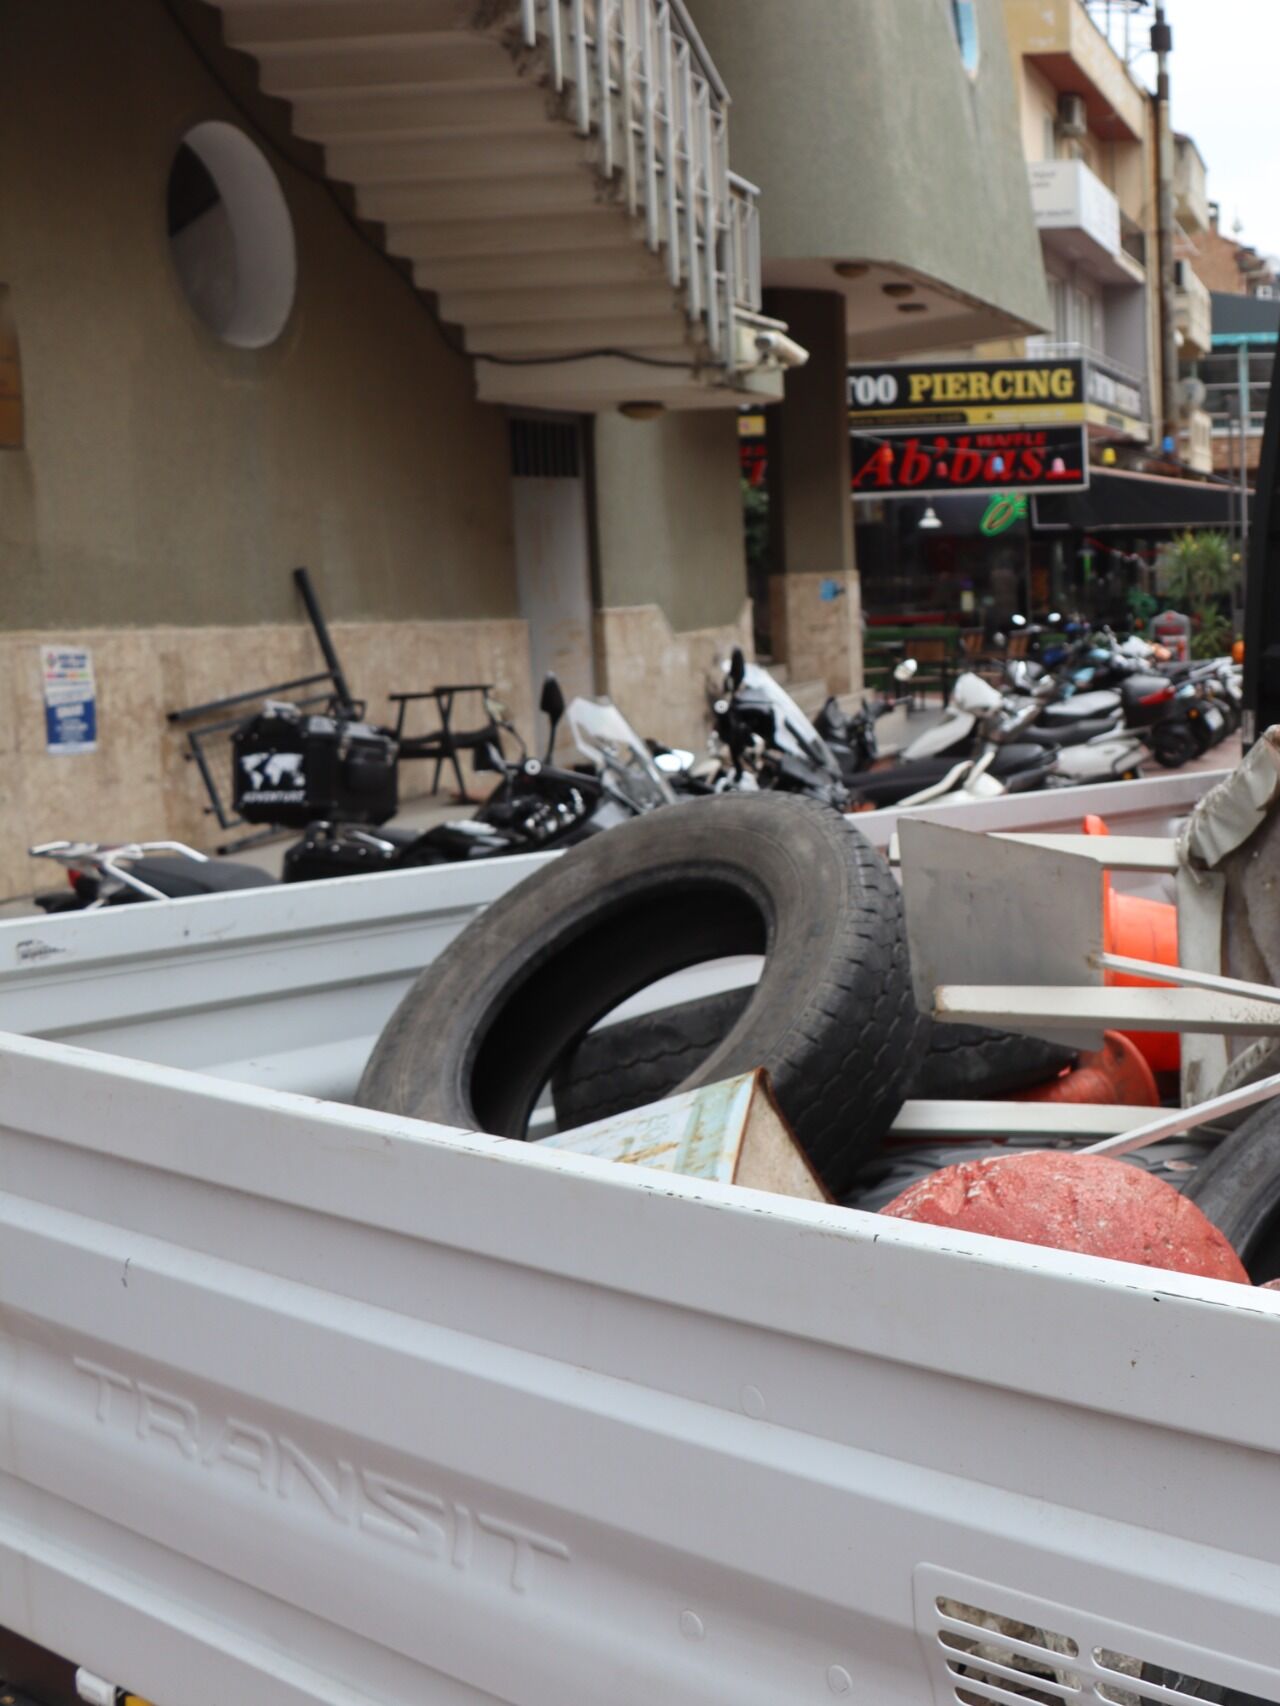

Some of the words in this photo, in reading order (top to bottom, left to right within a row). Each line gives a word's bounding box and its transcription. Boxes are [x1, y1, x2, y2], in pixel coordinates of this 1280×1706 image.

[907, 367, 1075, 402] PIERCING
[975, 432, 1047, 447] WAFFLE
[72, 1355, 572, 1596] TRANSIT
